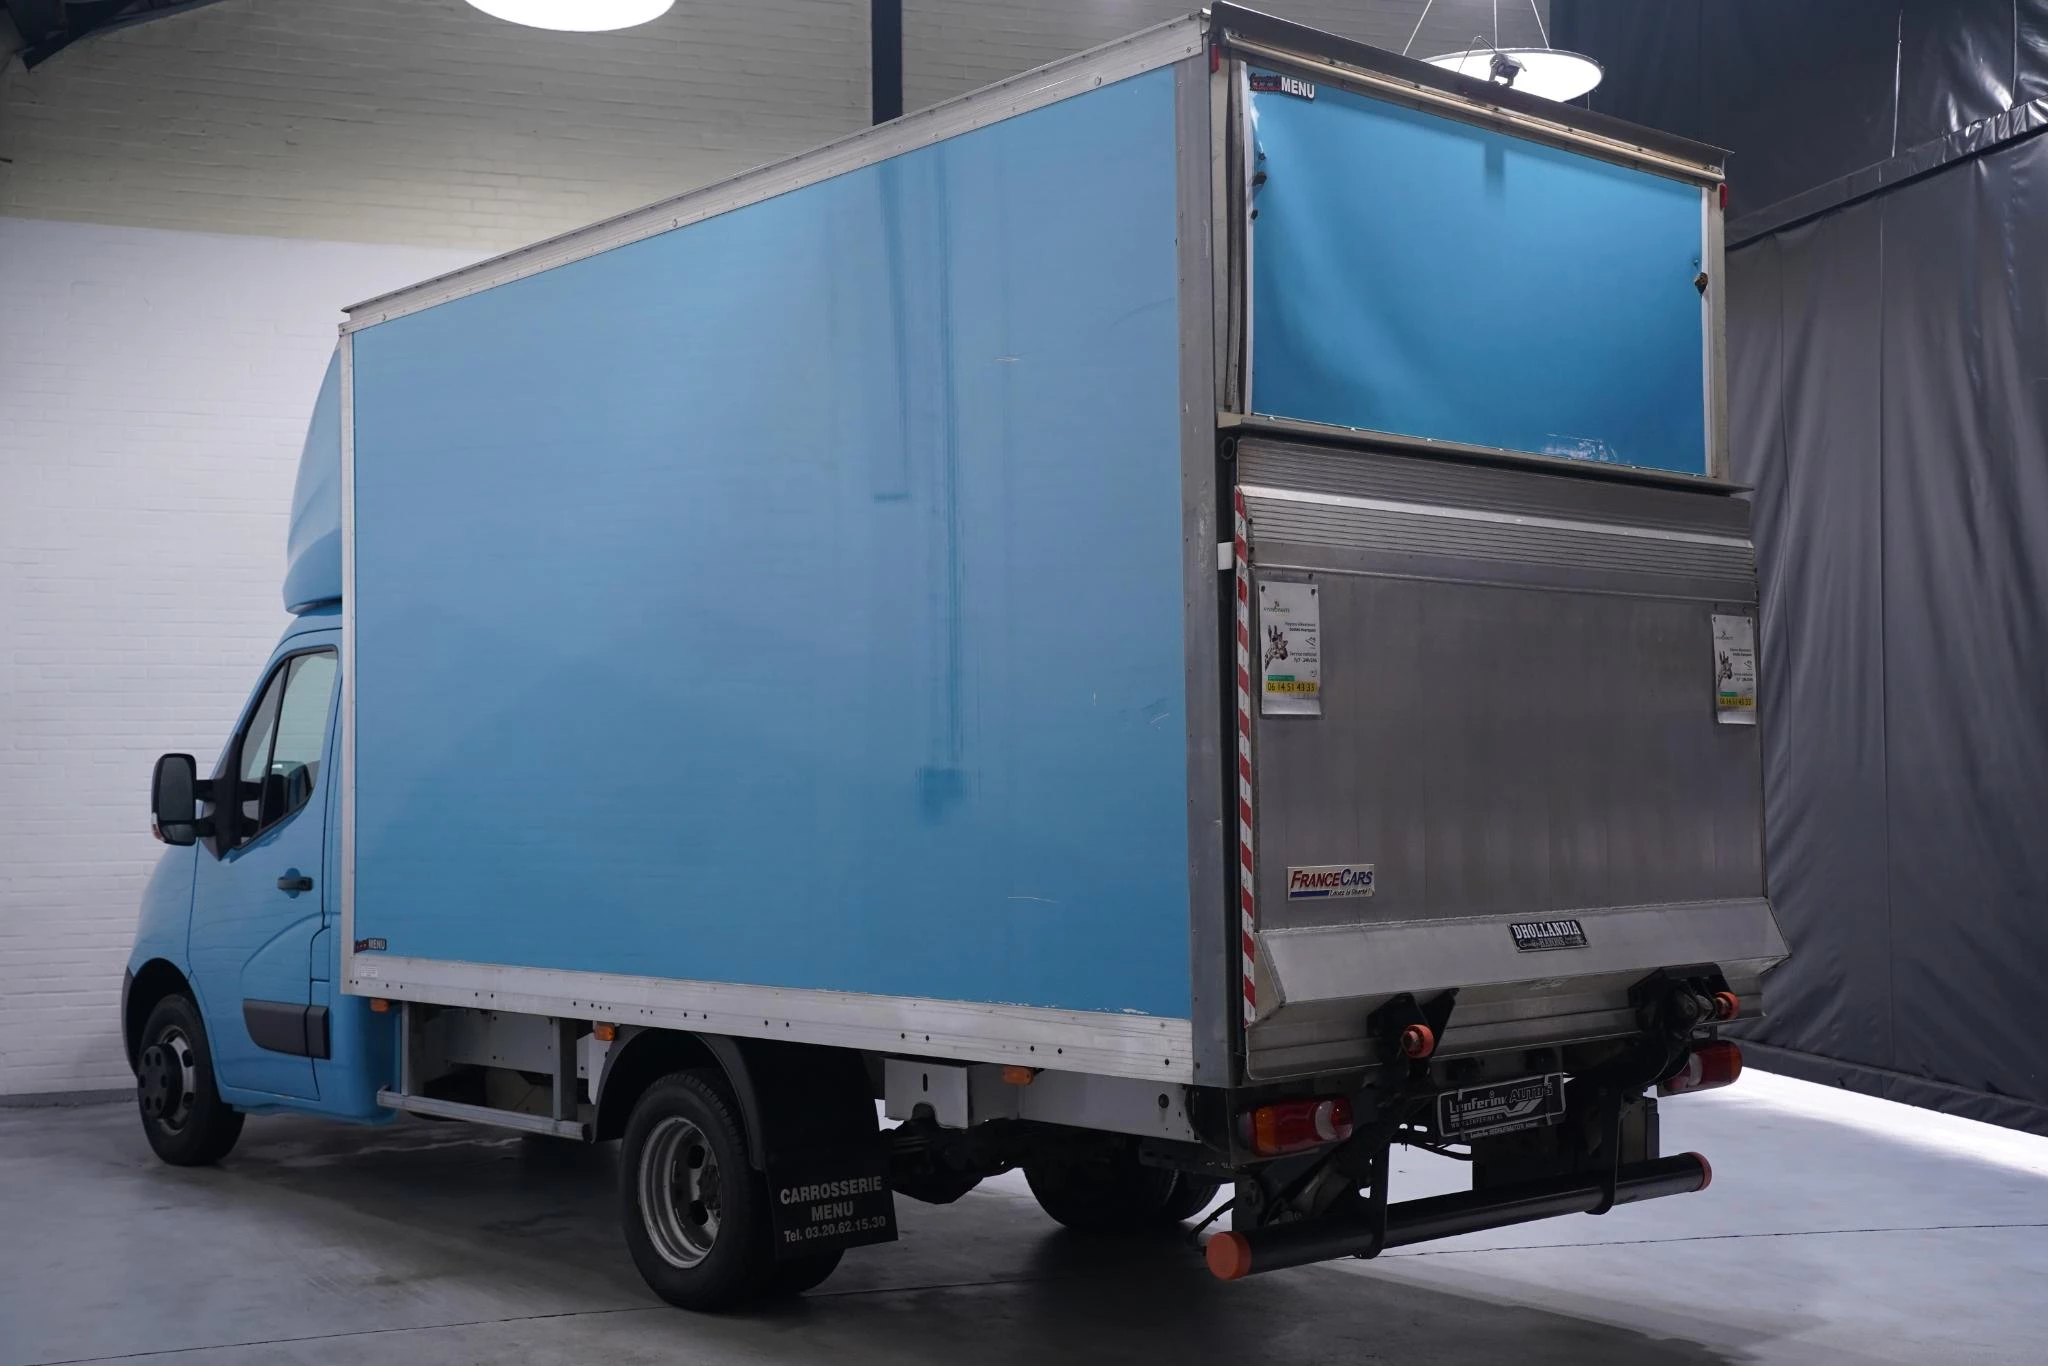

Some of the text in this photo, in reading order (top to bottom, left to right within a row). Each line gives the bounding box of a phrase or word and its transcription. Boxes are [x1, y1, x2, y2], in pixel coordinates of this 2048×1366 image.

[1281, 76, 1315, 99] MENU
[1268, 682, 1315, 692] 06 14 51 43 33
[1512, 921, 1581, 939] DHOLLANDIA
[780, 1176, 883, 1205] CARROSSERIE
[811, 1201, 854, 1222] MENU
[784, 1216, 886, 1243] Tel. 03.20.62.15.30
